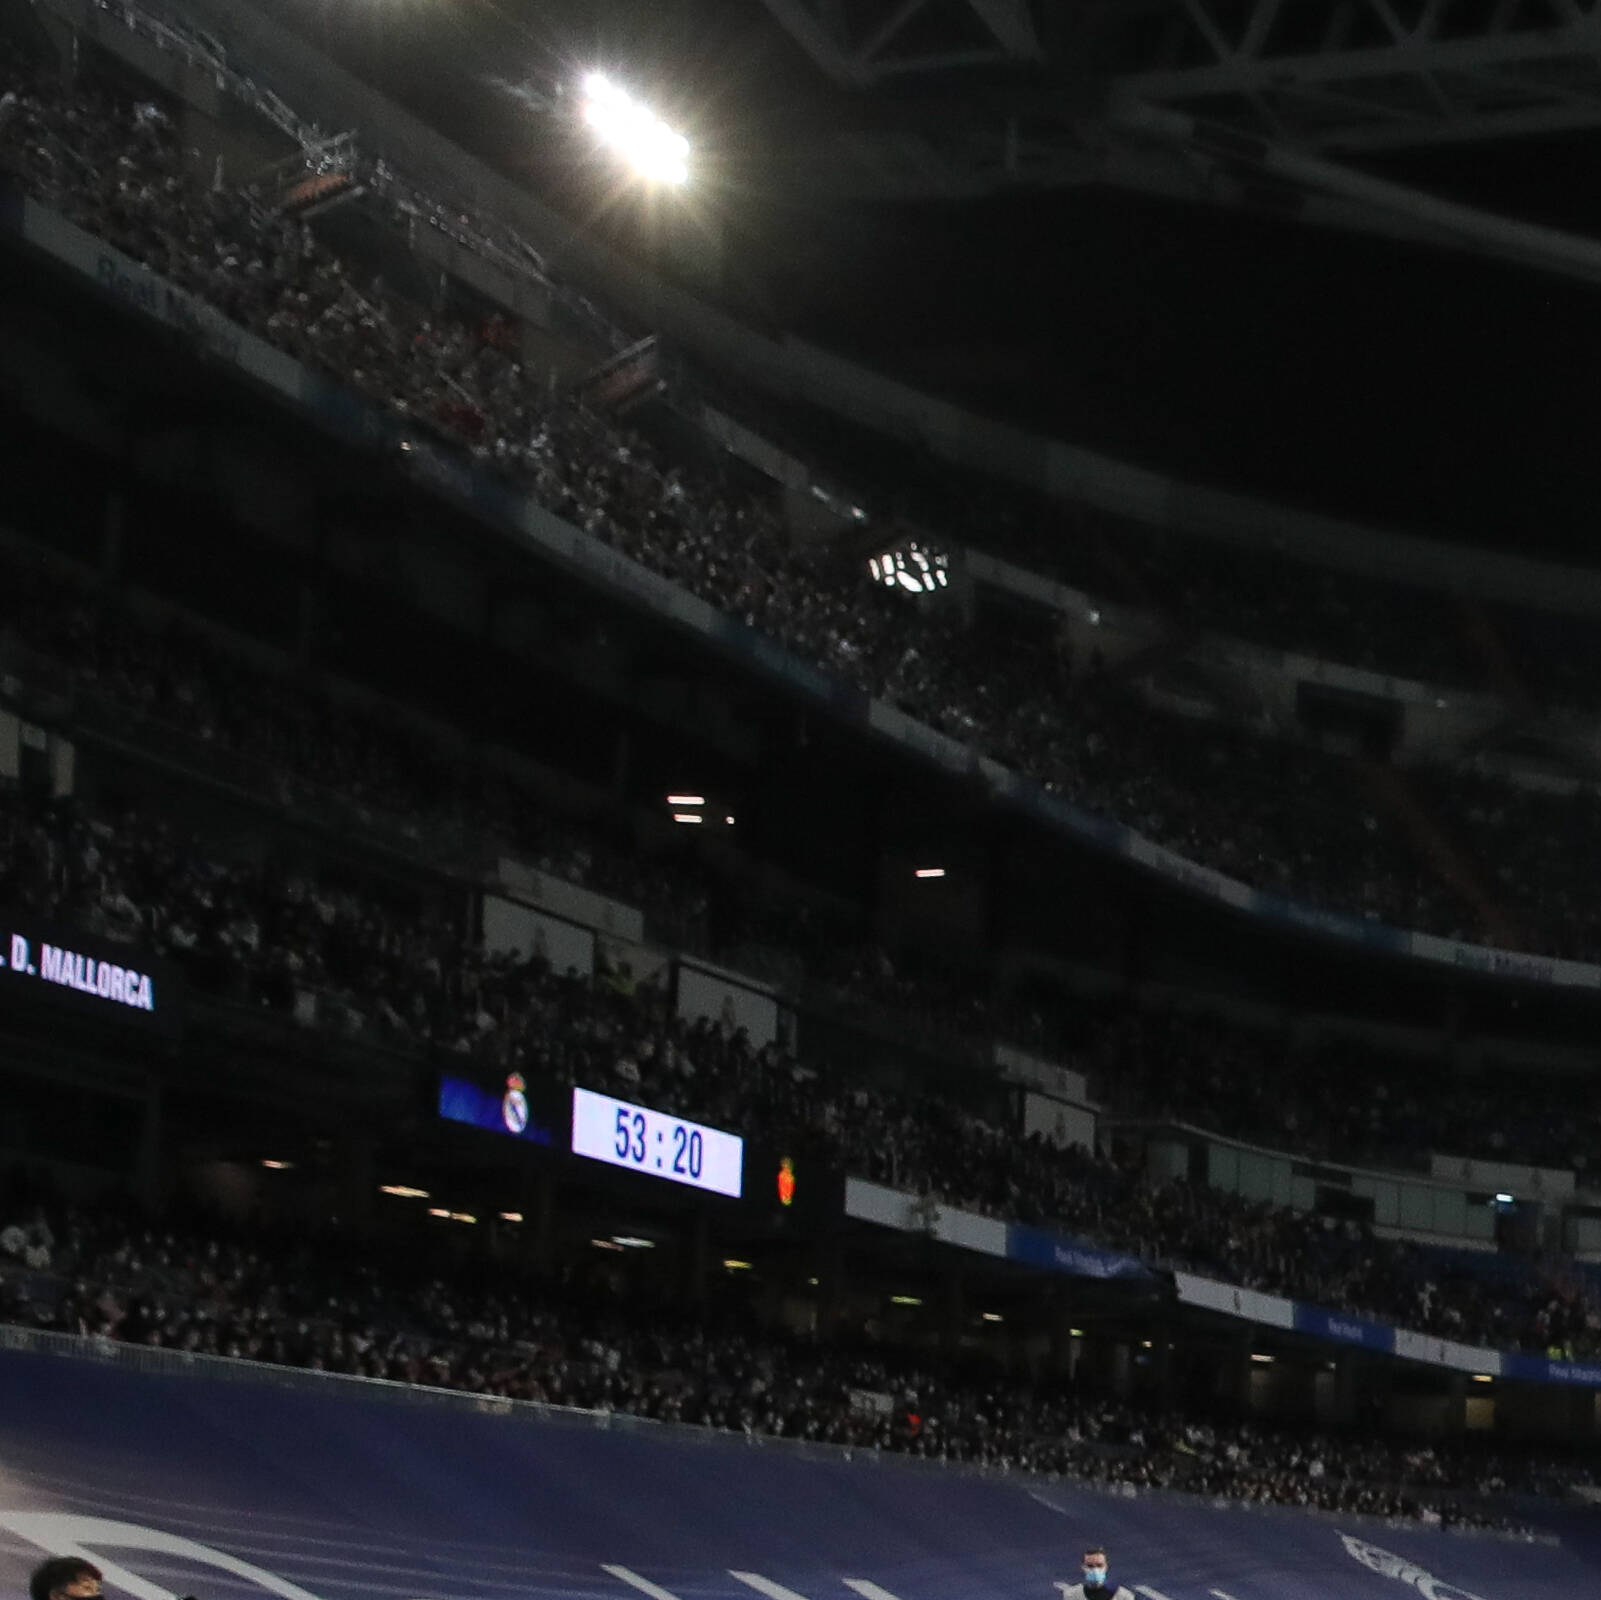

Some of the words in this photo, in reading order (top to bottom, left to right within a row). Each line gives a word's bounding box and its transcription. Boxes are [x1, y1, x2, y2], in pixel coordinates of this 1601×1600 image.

[11, 933, 36, 975] D.
[40, 942, 154, 1011] MALLORCA
[615, 1107, 646, 1163] 53
[673, 1125, 702, 1178] 20
